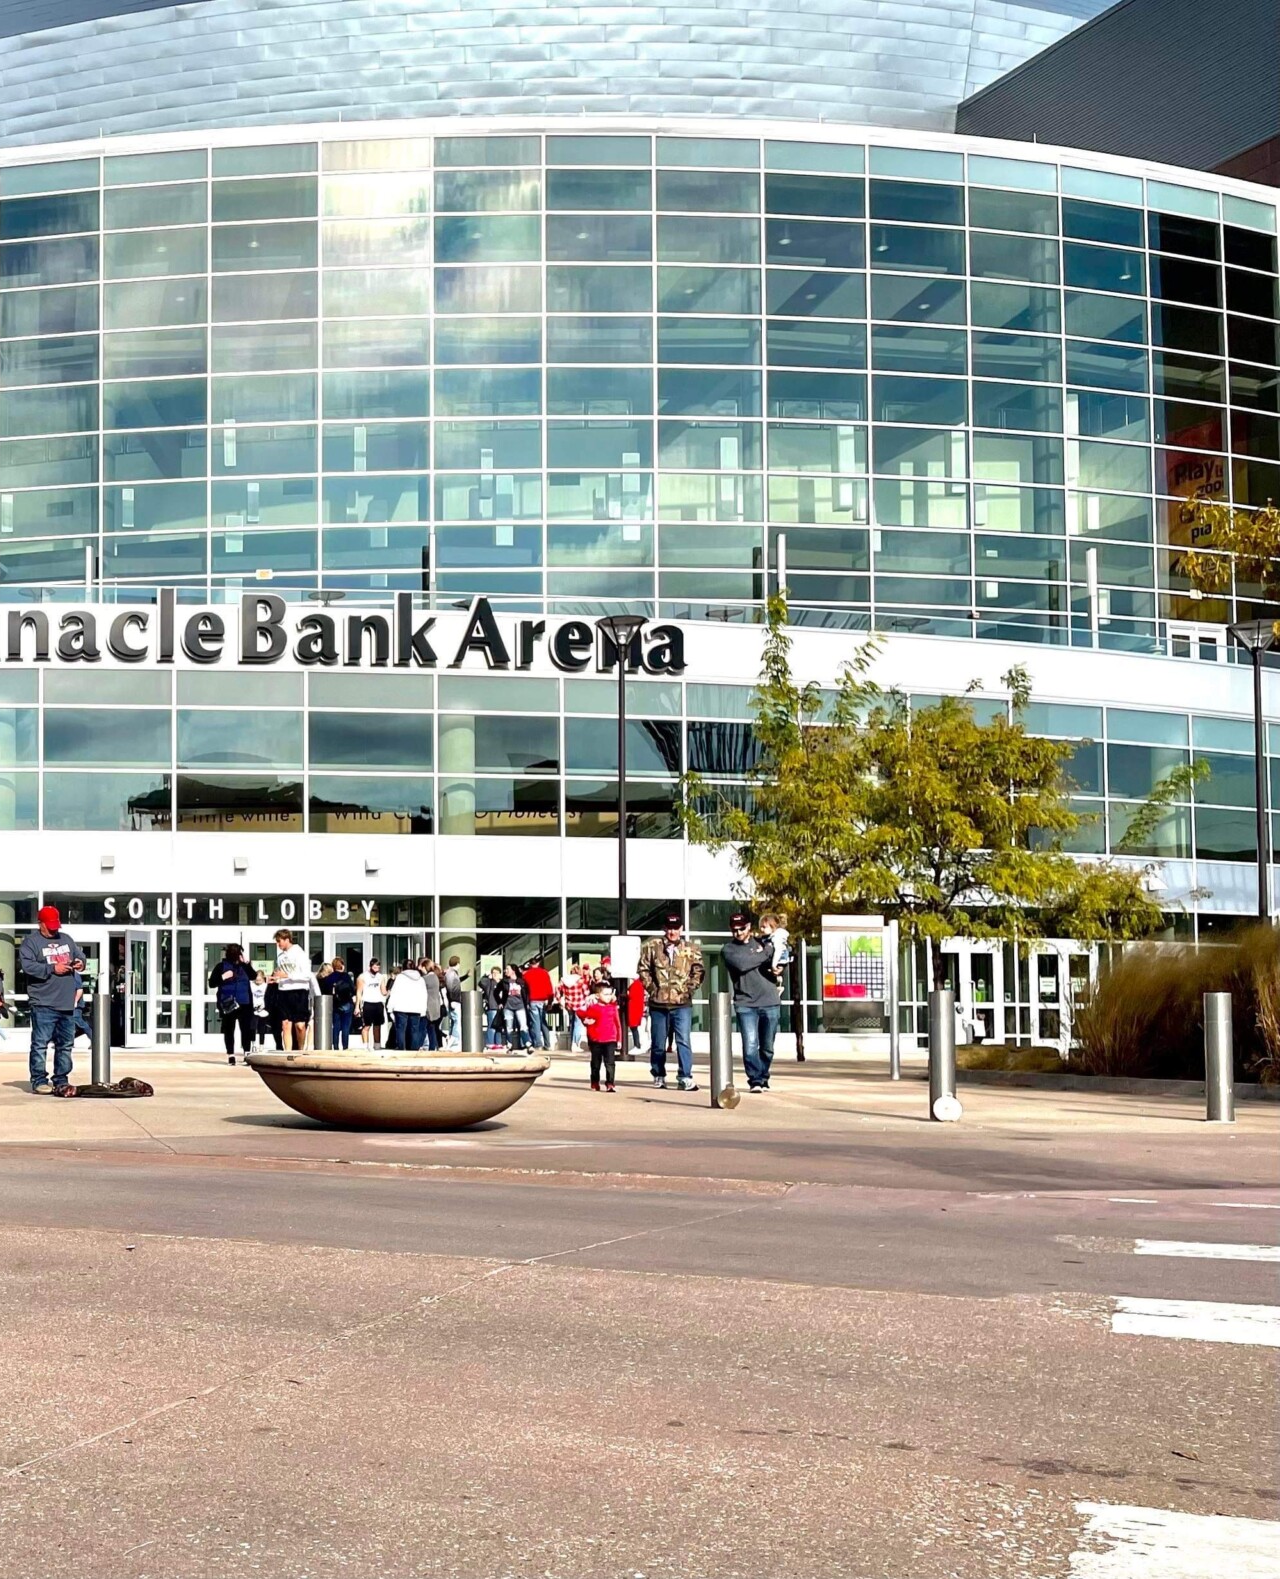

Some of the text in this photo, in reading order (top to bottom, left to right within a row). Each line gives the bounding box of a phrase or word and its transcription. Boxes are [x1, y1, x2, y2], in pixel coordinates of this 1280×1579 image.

[238, 592, 438, 668] Bank
[447, 595, 689, 676] Arena
[103, 897, 375, 920] SOUTH LOBBY
